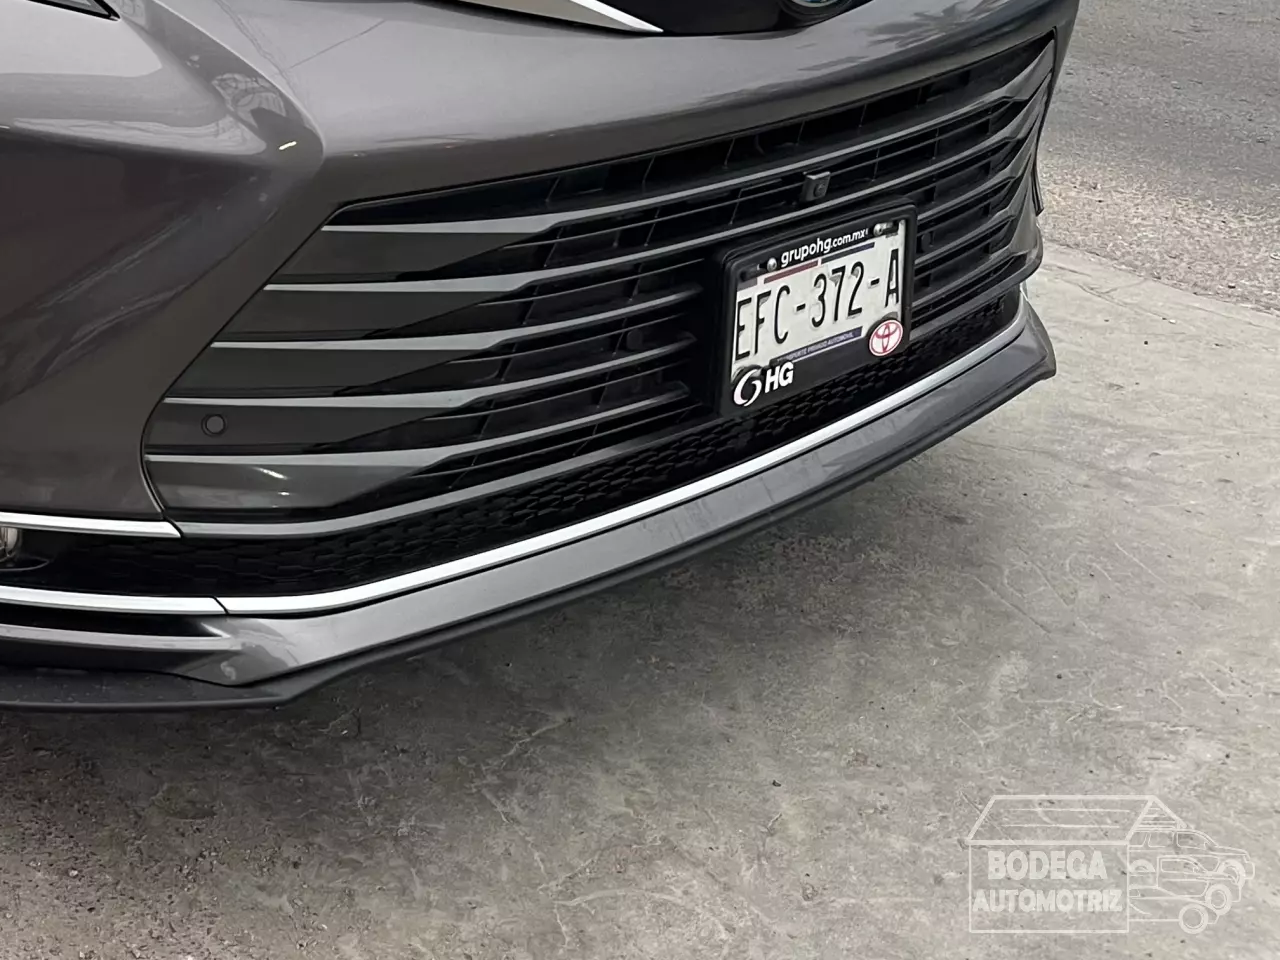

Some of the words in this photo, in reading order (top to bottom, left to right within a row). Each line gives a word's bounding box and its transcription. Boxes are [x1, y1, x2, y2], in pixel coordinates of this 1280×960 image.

[781, 228, 866, 268] grupohg.com.mx
[735, 248, 900, 362] EFC-372-A
[764, 361, 794, 393] HG
